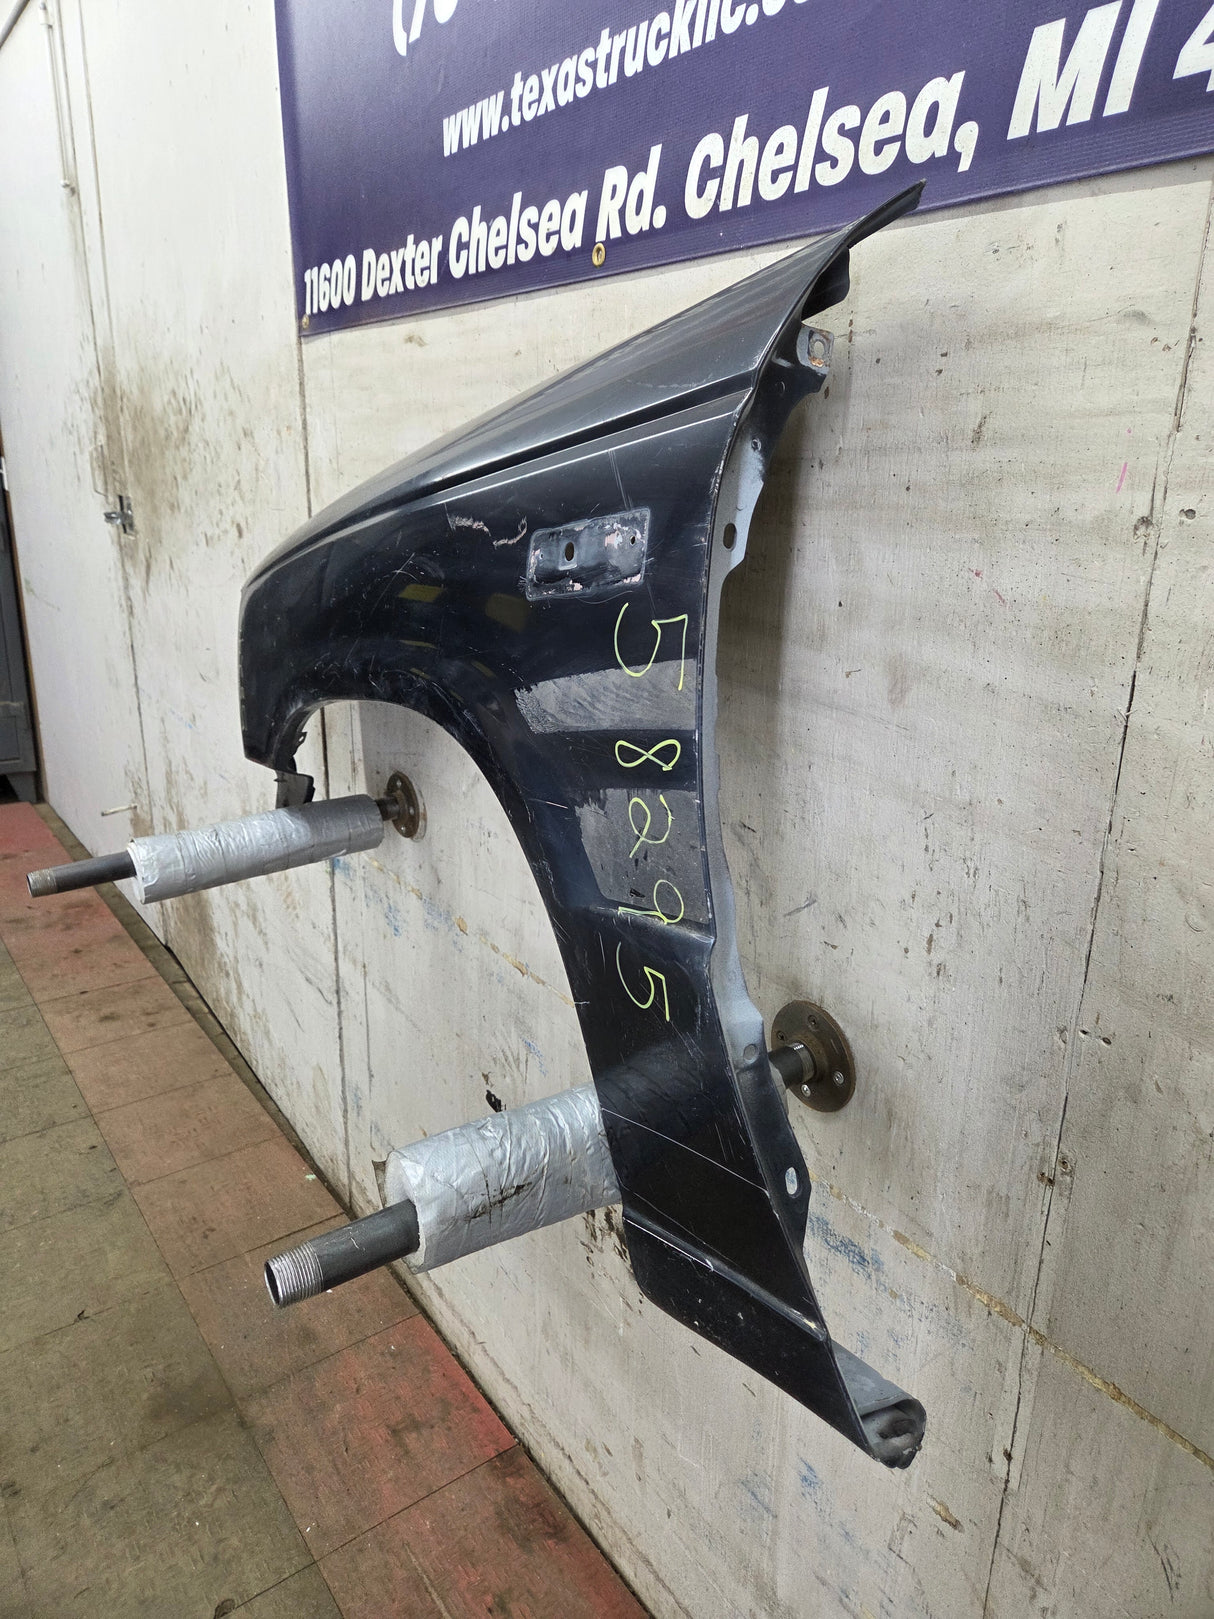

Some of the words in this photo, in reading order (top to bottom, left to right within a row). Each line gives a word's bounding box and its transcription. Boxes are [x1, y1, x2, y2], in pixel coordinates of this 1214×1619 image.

[304, 255, 356, 316] 11600
[361, 234, 443, 301] Dexter
[449, 191, 588, 279] Chelsea
[595, 143, 667, 243] Rd.
[684, 70, 979, 219] Chelsea,
[1006, 0, 1160, 140] MI
[443, 0, 808, 157] www.texastruckllc.
